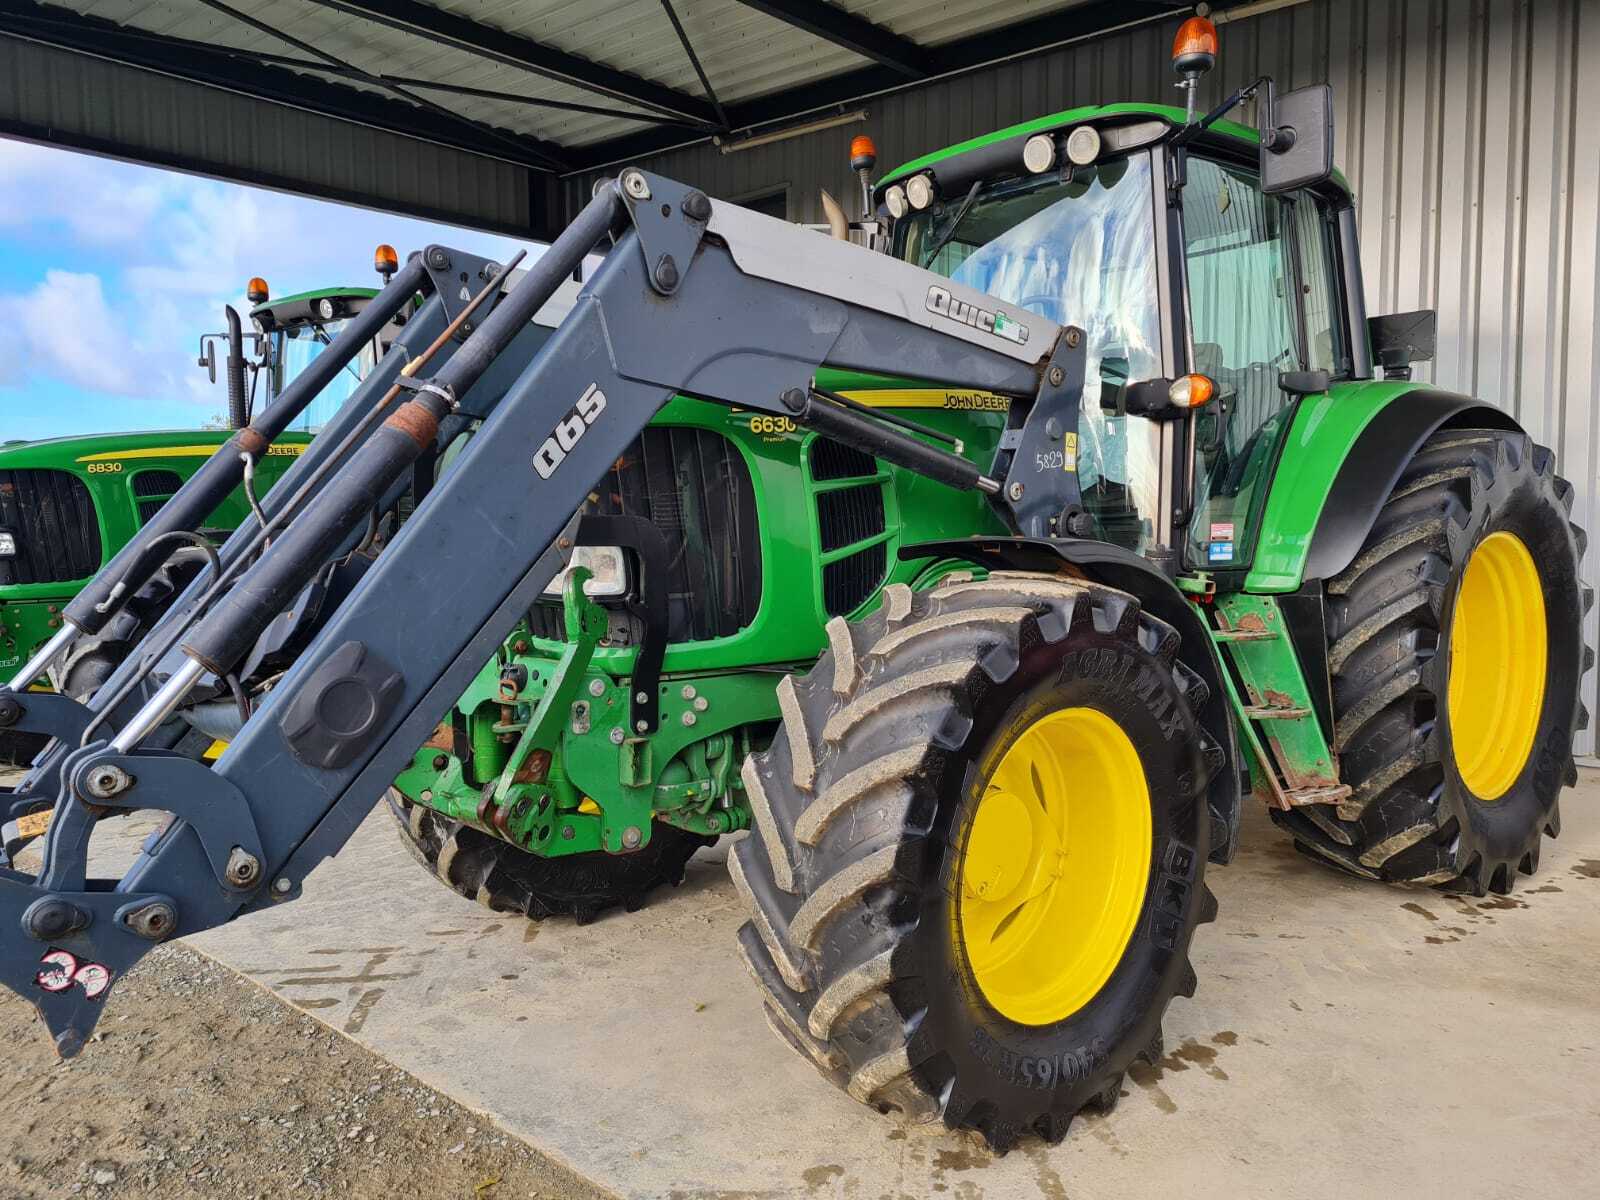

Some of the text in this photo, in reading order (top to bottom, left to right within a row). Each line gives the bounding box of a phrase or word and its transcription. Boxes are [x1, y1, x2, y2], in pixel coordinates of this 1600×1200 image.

[943, 393, 974, 407] JOHN
[532, 382, 607, 480] Q65
[750, 416, 797, 433] 6630
[87, 462, 123, 474] 6830
[1036, 450, 1063, 473] 5829
[1154, 840, 1196, 950] BKT
